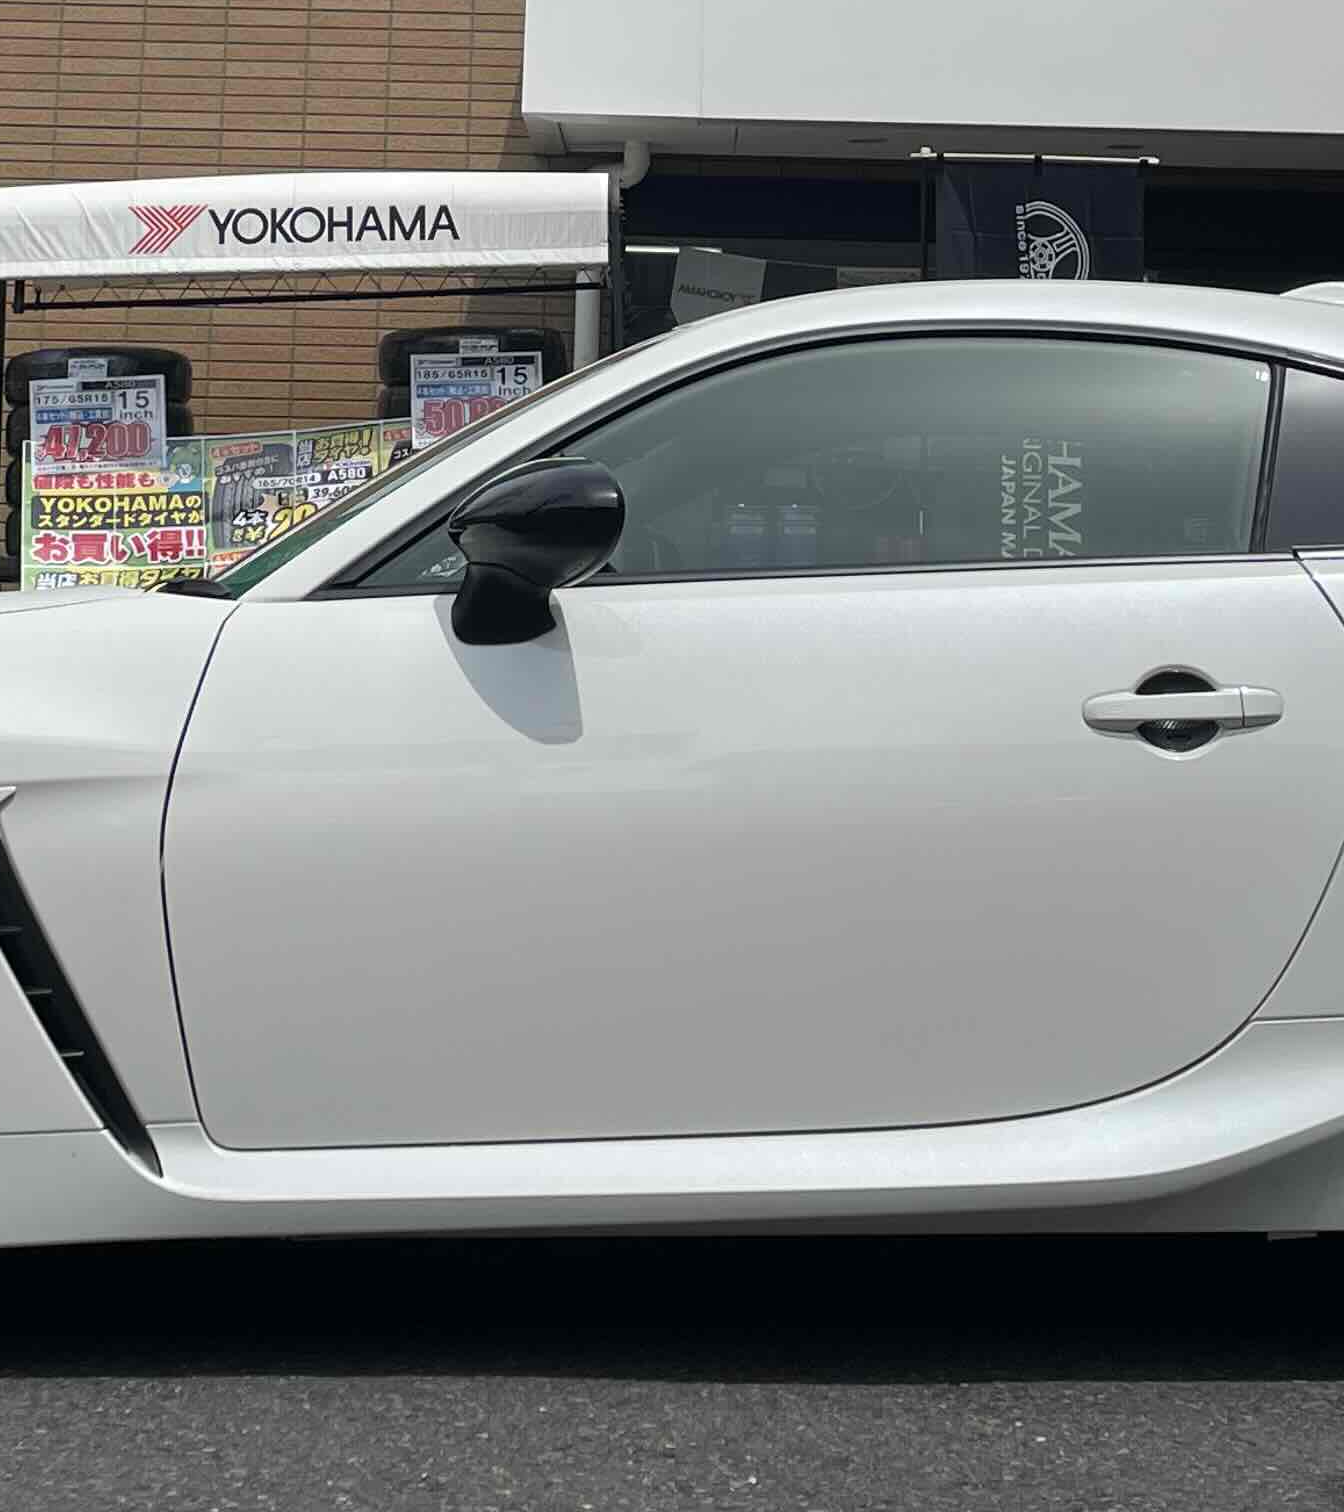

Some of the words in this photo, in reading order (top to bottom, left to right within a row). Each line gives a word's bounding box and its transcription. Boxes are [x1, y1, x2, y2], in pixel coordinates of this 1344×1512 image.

[209, 204, 460, 245] YOKOHAMA
[497, 367, 528, 386] 15
[117, 390, 151, 409] 15
[119, 408, 153, 421] inch
[327, 467, 367, 482] A580
[1000, 455, 1017, 524] JAPAN
[39, 494, 202, 514] YOKOHAMAの
[37, 510, 205, 529] スタンダードタイヤが
[33, 528, 206, 563] お買い得!!
